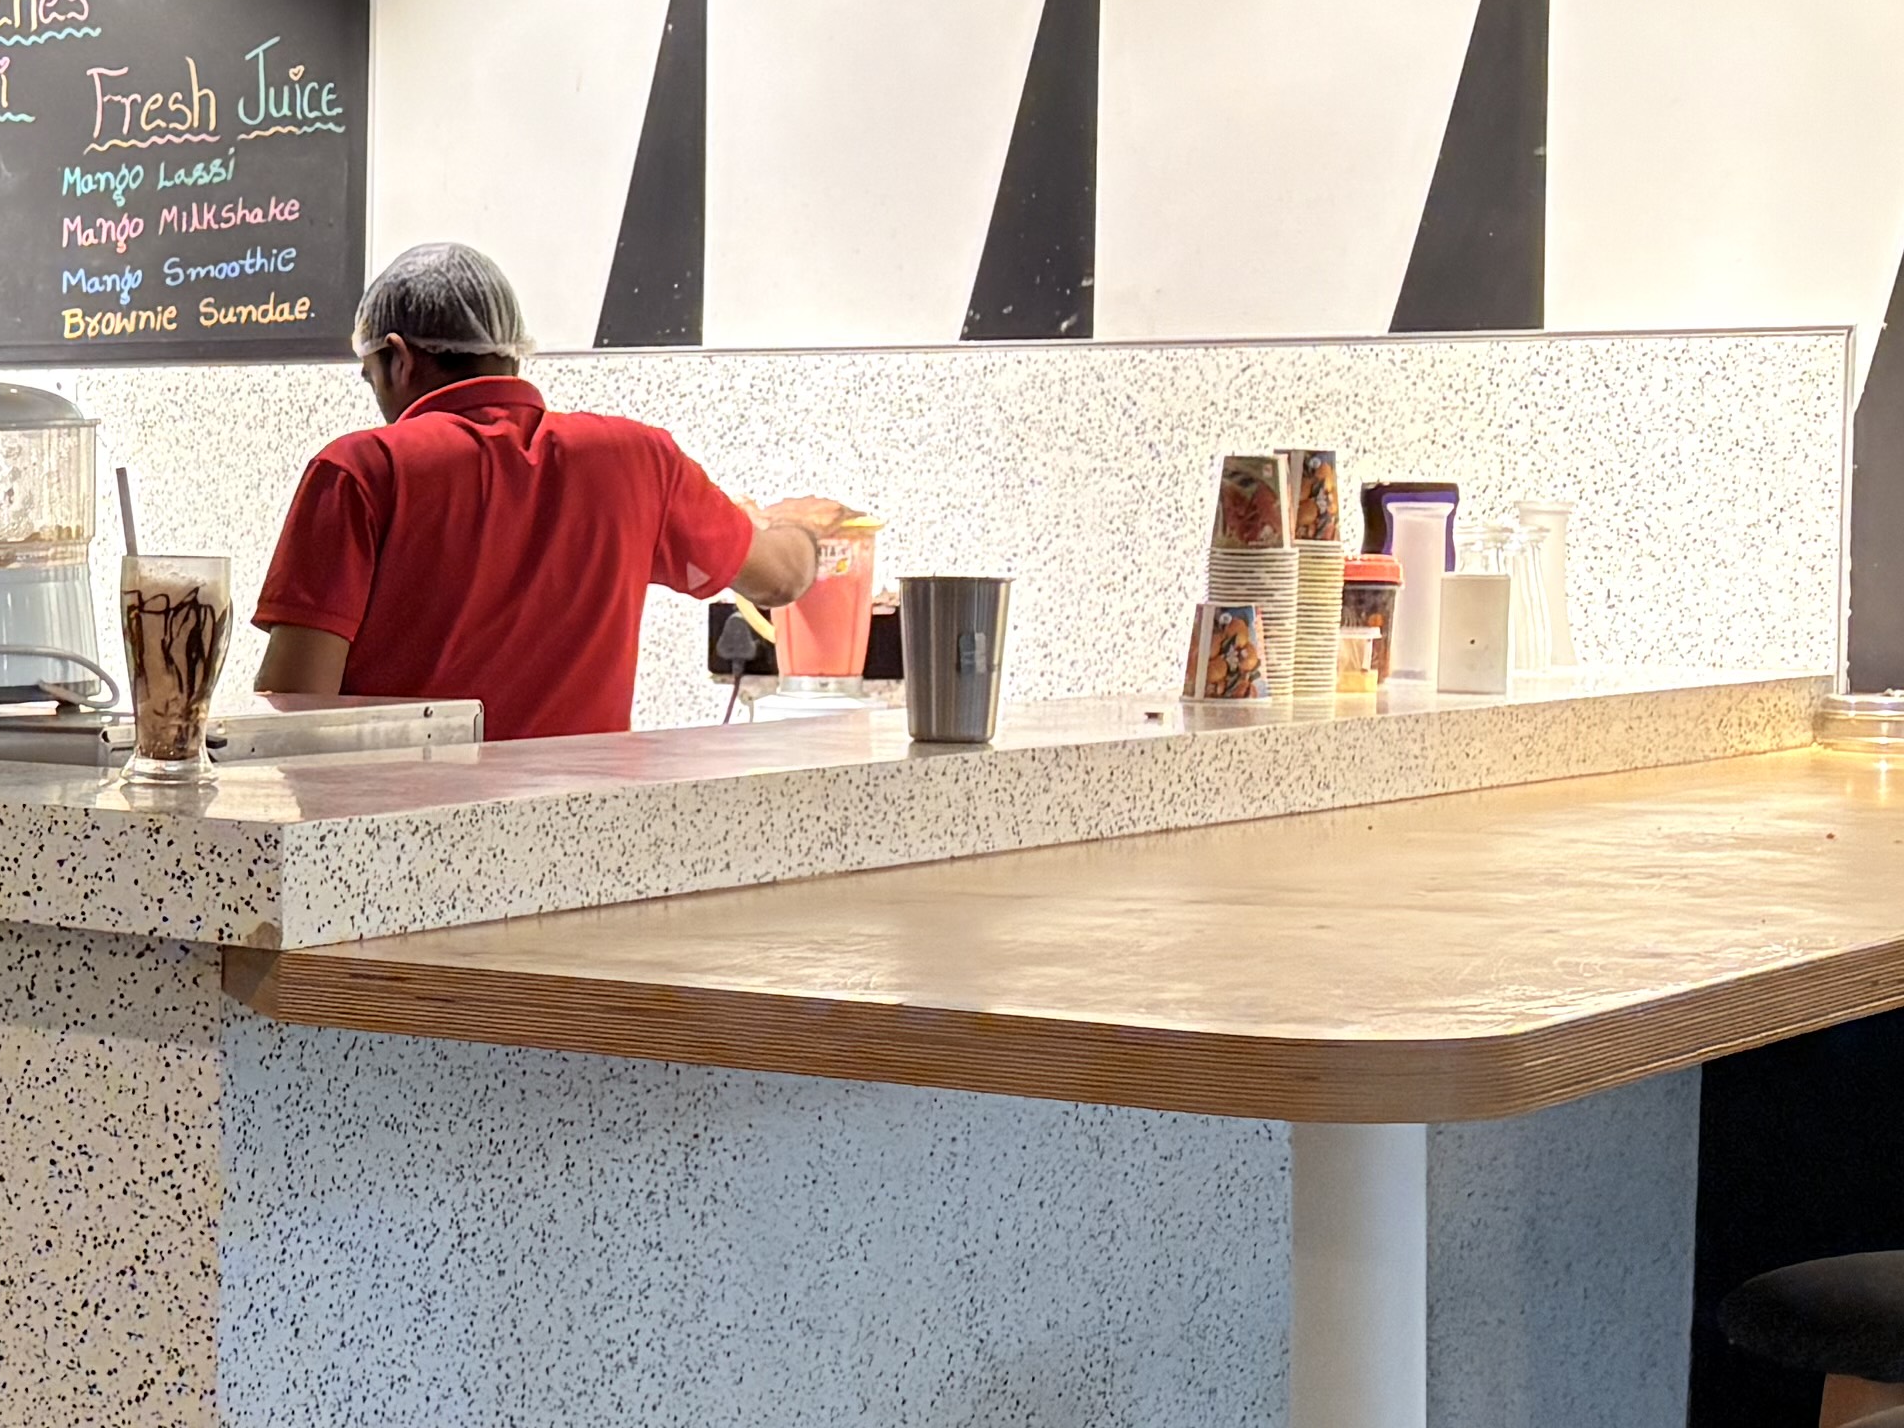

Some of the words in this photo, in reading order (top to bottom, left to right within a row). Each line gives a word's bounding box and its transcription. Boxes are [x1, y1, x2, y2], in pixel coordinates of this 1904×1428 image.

[86, 56, 216, 138] Fresh
[238, 36, 343, 125] Juice
[62, 164, 144, 207] Mango
[156, 147, 236, 190] Lassi
[62, 213, 144, 253] Mango
[62, 265, 143, 305] Mango
[163, 246, 297, 286] Smoothie
[61, 305, 178, 340] Brownie
